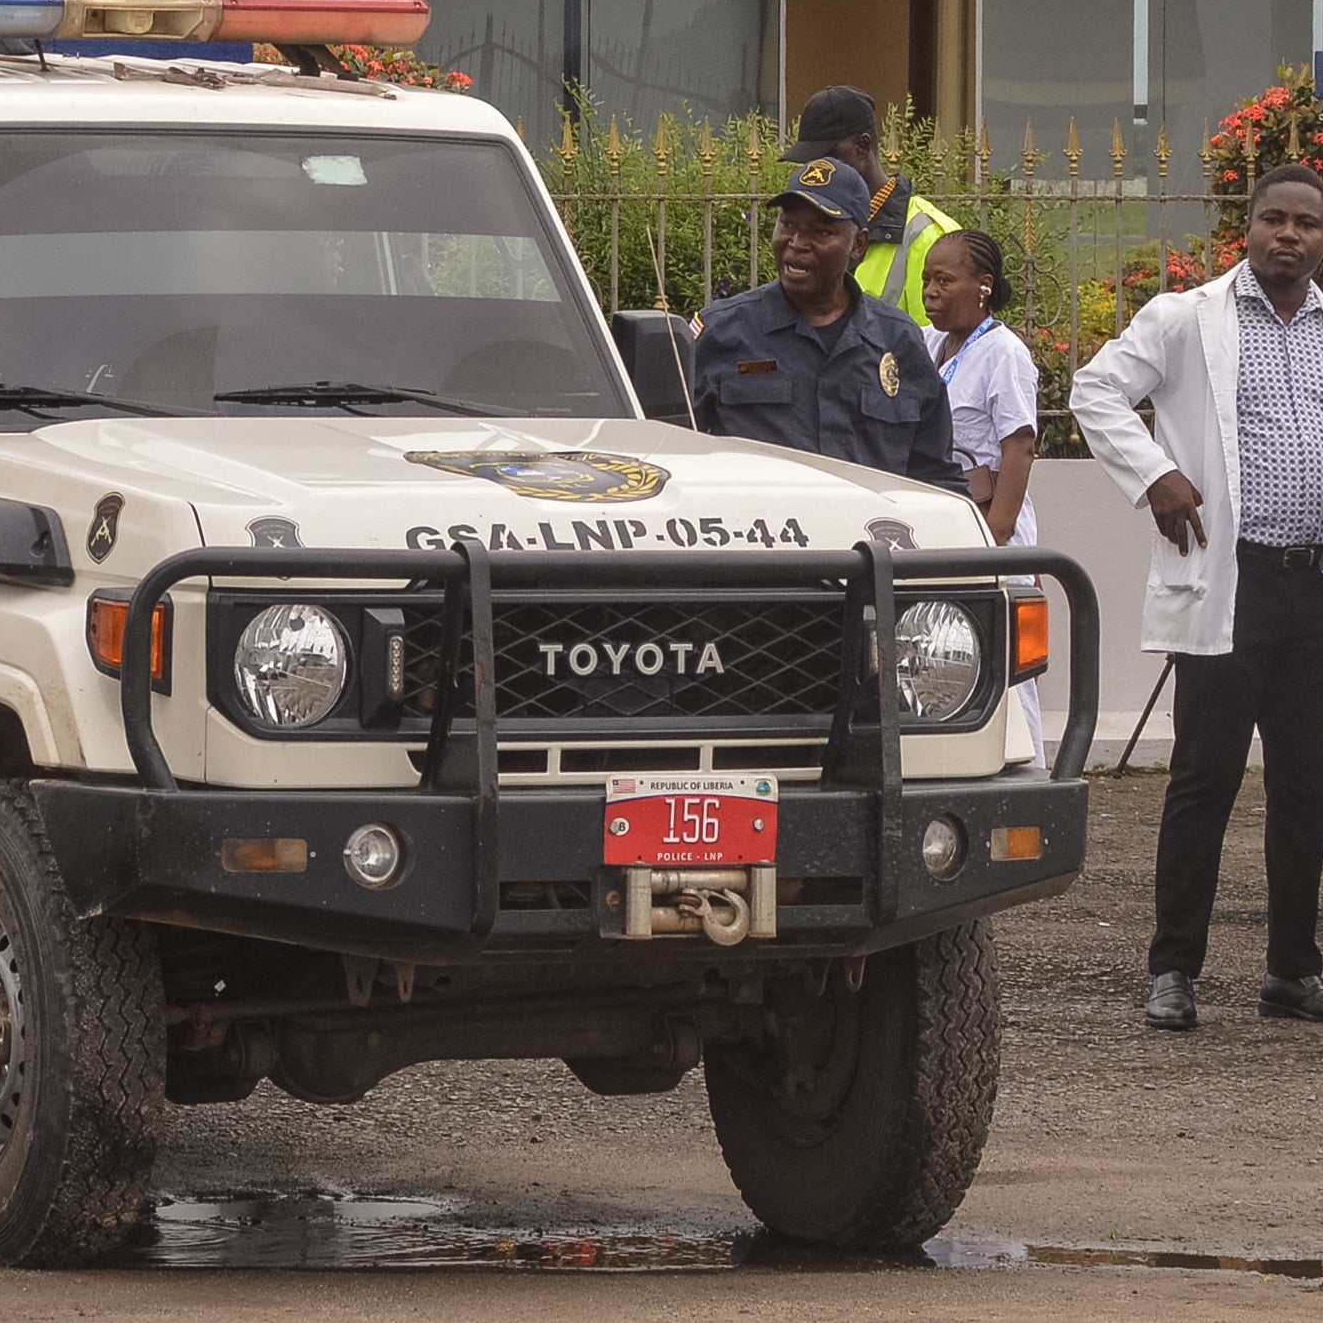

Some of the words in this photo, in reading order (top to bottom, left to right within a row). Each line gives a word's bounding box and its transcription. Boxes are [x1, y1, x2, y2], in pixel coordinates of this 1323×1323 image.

[538, 642, 725, 676] TOYOTA
[650, 781, 688, 791] REPUBLIC
[690, 781, 701, 790] OF
[703, 781, 734, 790] LIBERIA
[662, 797, 720, 843] 156
[657, 852, 693, 861] POLICE
[704, 852, 724, 861] LNP
